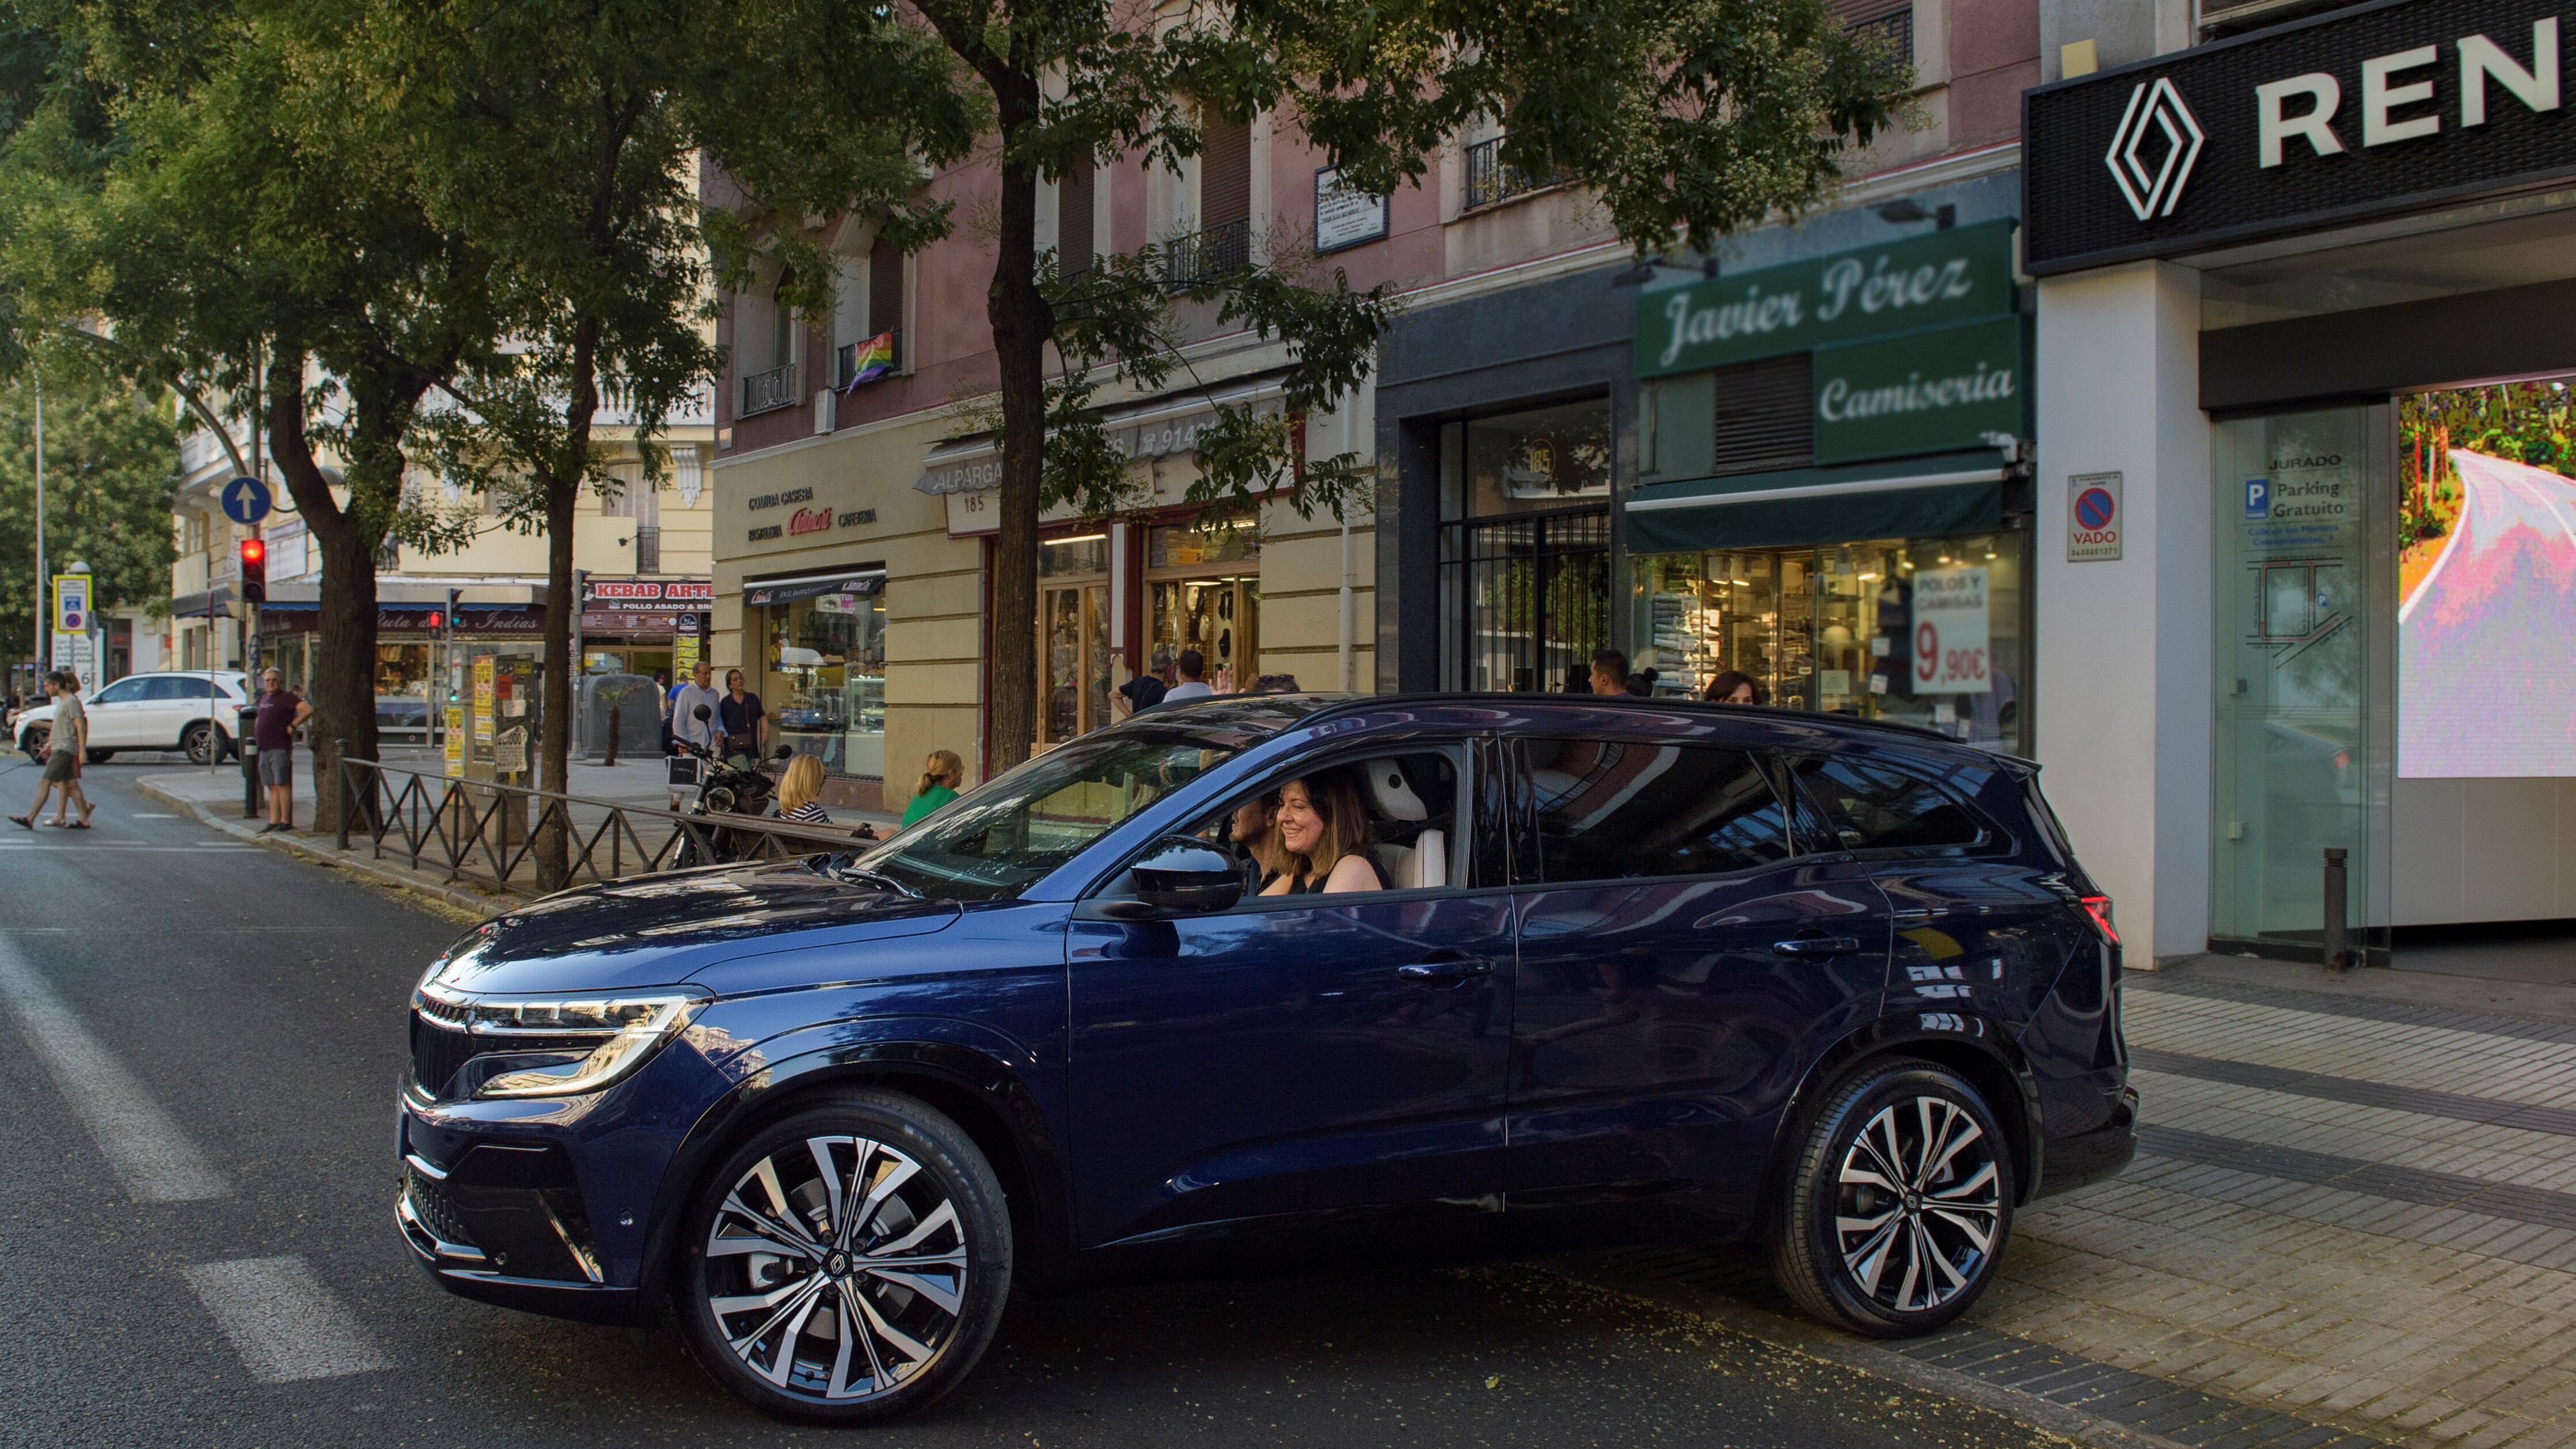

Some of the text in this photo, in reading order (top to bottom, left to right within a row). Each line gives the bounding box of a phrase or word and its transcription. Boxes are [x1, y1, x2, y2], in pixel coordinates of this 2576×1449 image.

[2255, 16, 2560, 169] REN
[1660, 255, 1973, 367] Javier Pérez
[1819, 362, 2015, 422] Camiseria
[1530, 449, 1550, 473] 185
[2269, 455, 2341, 471] JURADO
[2277, 481, 2339, 498] Parking
[749, 487, 814, 510] COMIDA CASERA
[964, 496, 984, 513] 185
[2274, 500, 2343, 517] Gratuito
[838, 509, 876, 527] CAFETERIA
[2073, 531, 2116, 544] VADO
[595, 583, 661, 599] KEBAB
[1919, 576, 1980, 591] POLOS Y
[1917, 594, 1983, 612] CAMISAS
[475, 612, 538, 629] Indias
